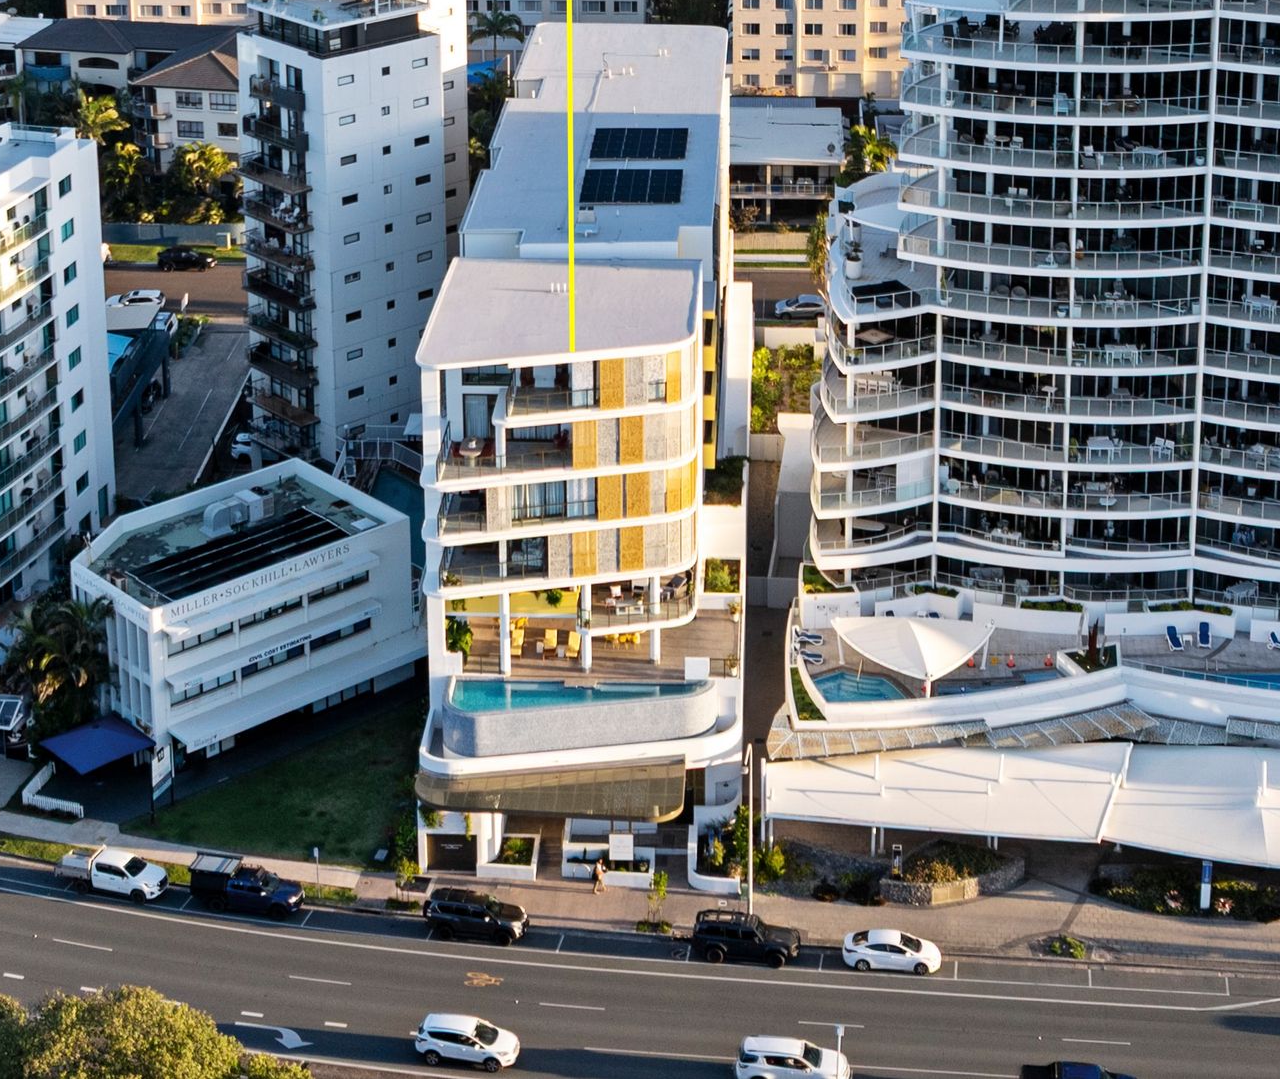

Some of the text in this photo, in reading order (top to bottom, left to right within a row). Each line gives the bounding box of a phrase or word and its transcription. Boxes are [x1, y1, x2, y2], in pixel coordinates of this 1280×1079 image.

[170, 593, 219, 619] MILLER
[225, 568, 290, 598] SOCKHILL
[294, 544, 350, 572] LAWYERS
[249, 653, 263, 663] CIVIL
[280, 634, 312, 651] ESTIMATING
